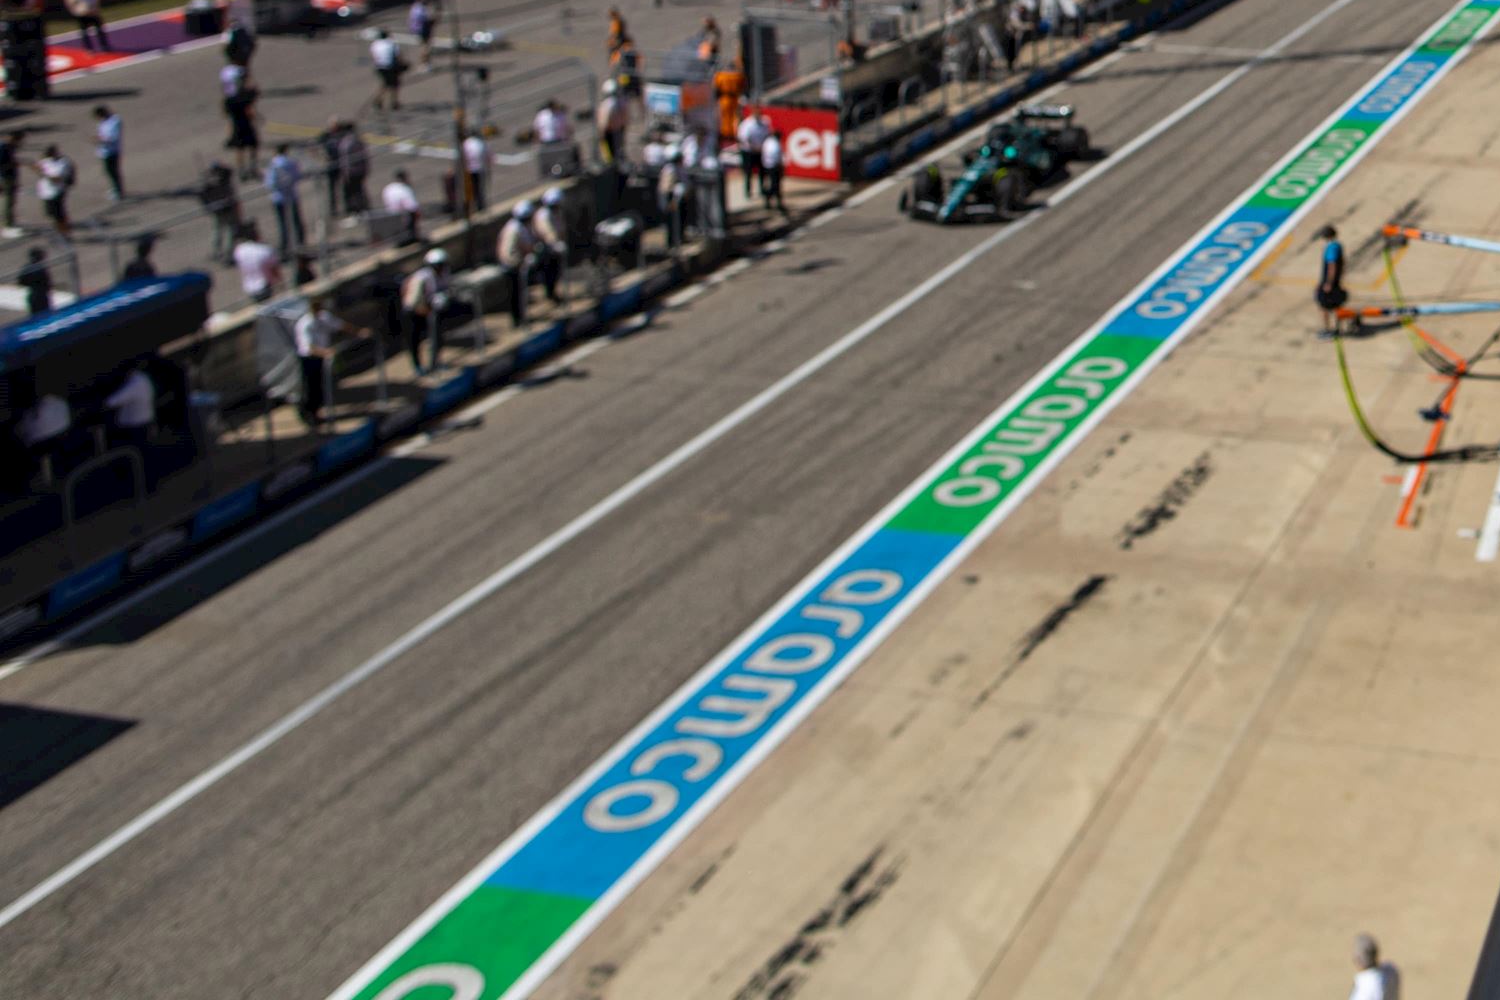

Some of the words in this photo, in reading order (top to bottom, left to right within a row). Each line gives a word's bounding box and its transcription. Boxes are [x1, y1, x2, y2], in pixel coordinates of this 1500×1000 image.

[1264, 127, 1367, 199] aramco
[1135, 221, 1269, 319] aramco
[931, 356, 1128, 508] aramco
[582, 568, 905, 834] aramco
